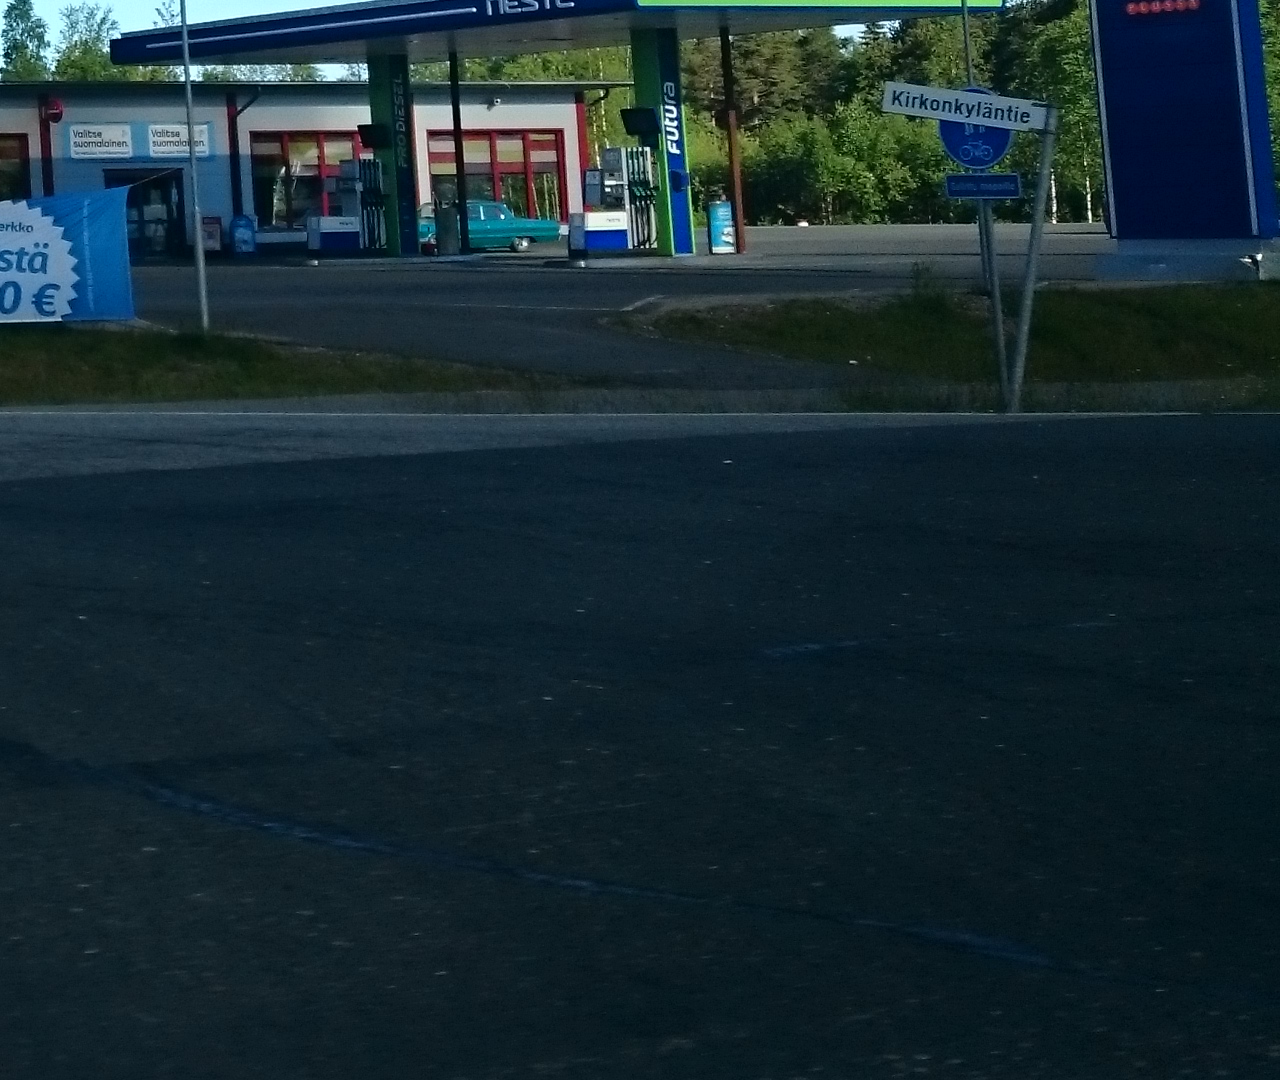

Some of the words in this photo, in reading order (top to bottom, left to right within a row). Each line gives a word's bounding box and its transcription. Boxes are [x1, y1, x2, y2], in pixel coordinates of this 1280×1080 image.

[891, 90, 1031, 124] Kirkonkyläntie
[72, 129, 102, 139] Valitse
[151, 129, 181, 138] Valitse
[73, 139, 130, 148] suomalainen.
[152, 138, 206, 148] suomalaien.
[31, 283, 62, 317] €
